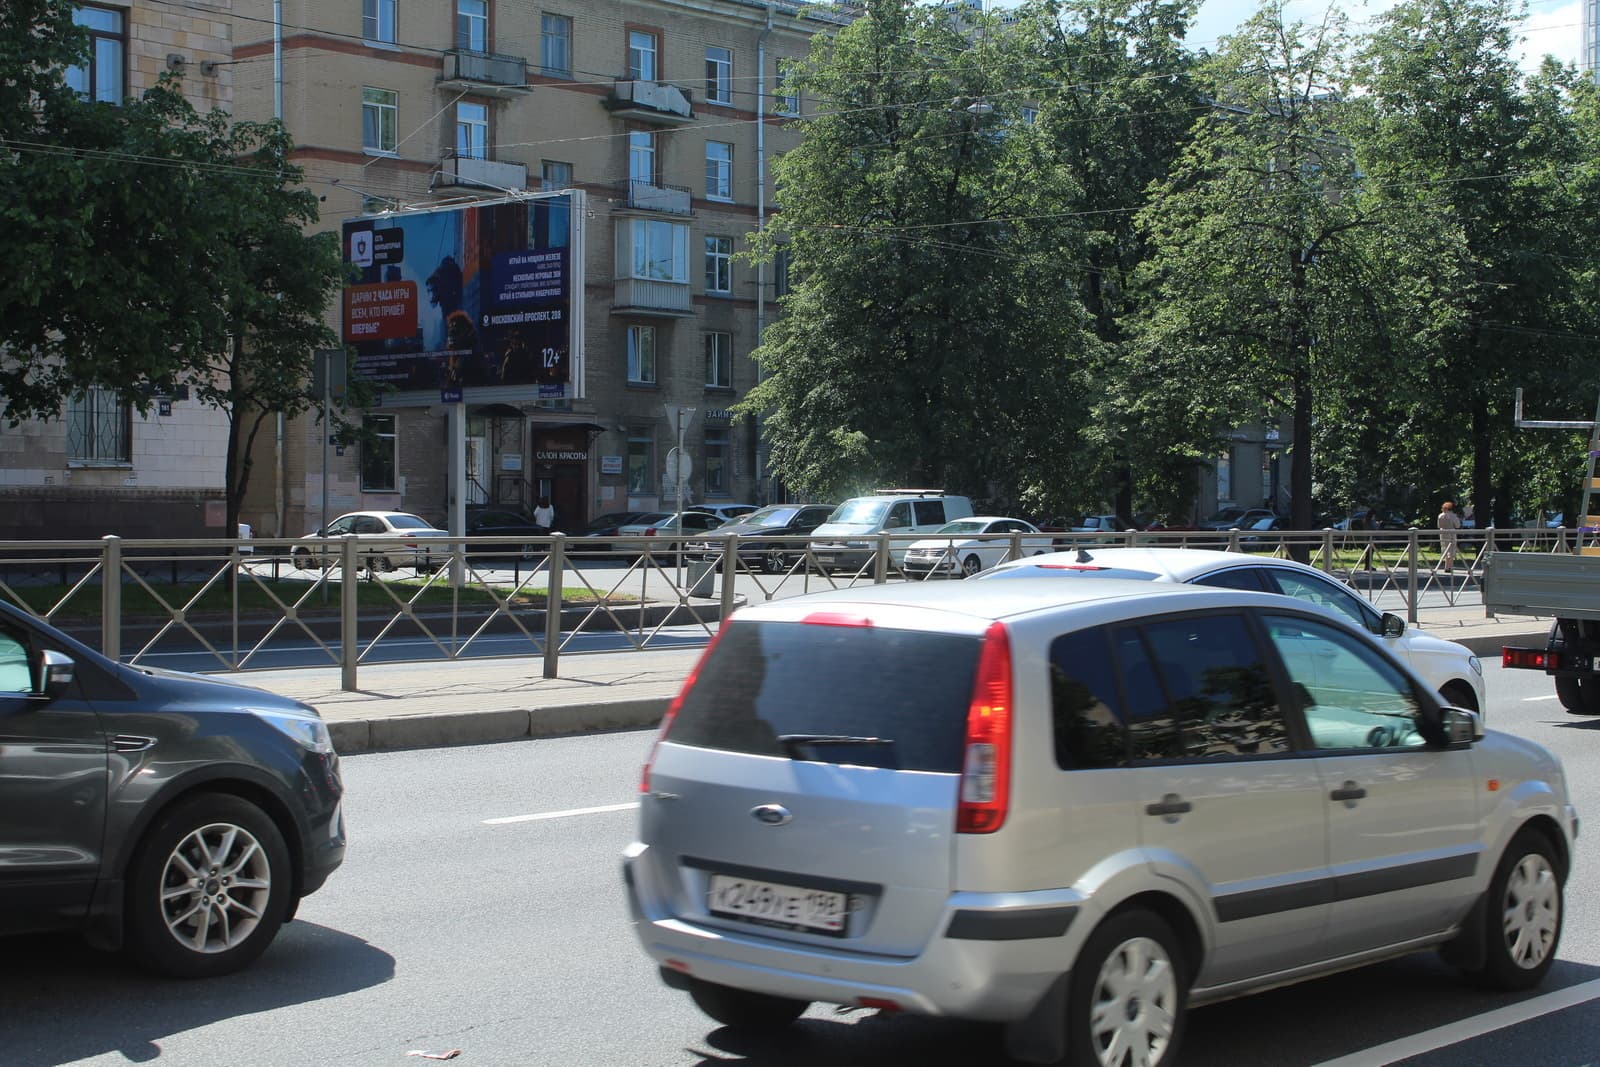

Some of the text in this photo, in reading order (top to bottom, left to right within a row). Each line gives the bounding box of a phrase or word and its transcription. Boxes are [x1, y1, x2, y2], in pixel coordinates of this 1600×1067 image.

[352, 291, 372, 305] ДАРИМ
[377, 289, 393, 300] ЧАСА
[393, 288, 410, 299] ИГРЫ
[352, 306, 368, 319] ВСЕМ,
[369, 306, 380, 317] КТО
[491, 312, 524, 325] МОСКОВСКИЙ
[542, 347, 560, 368] 12+
[536, 451, 587, 460] САЛОН КРАСОТЫ
